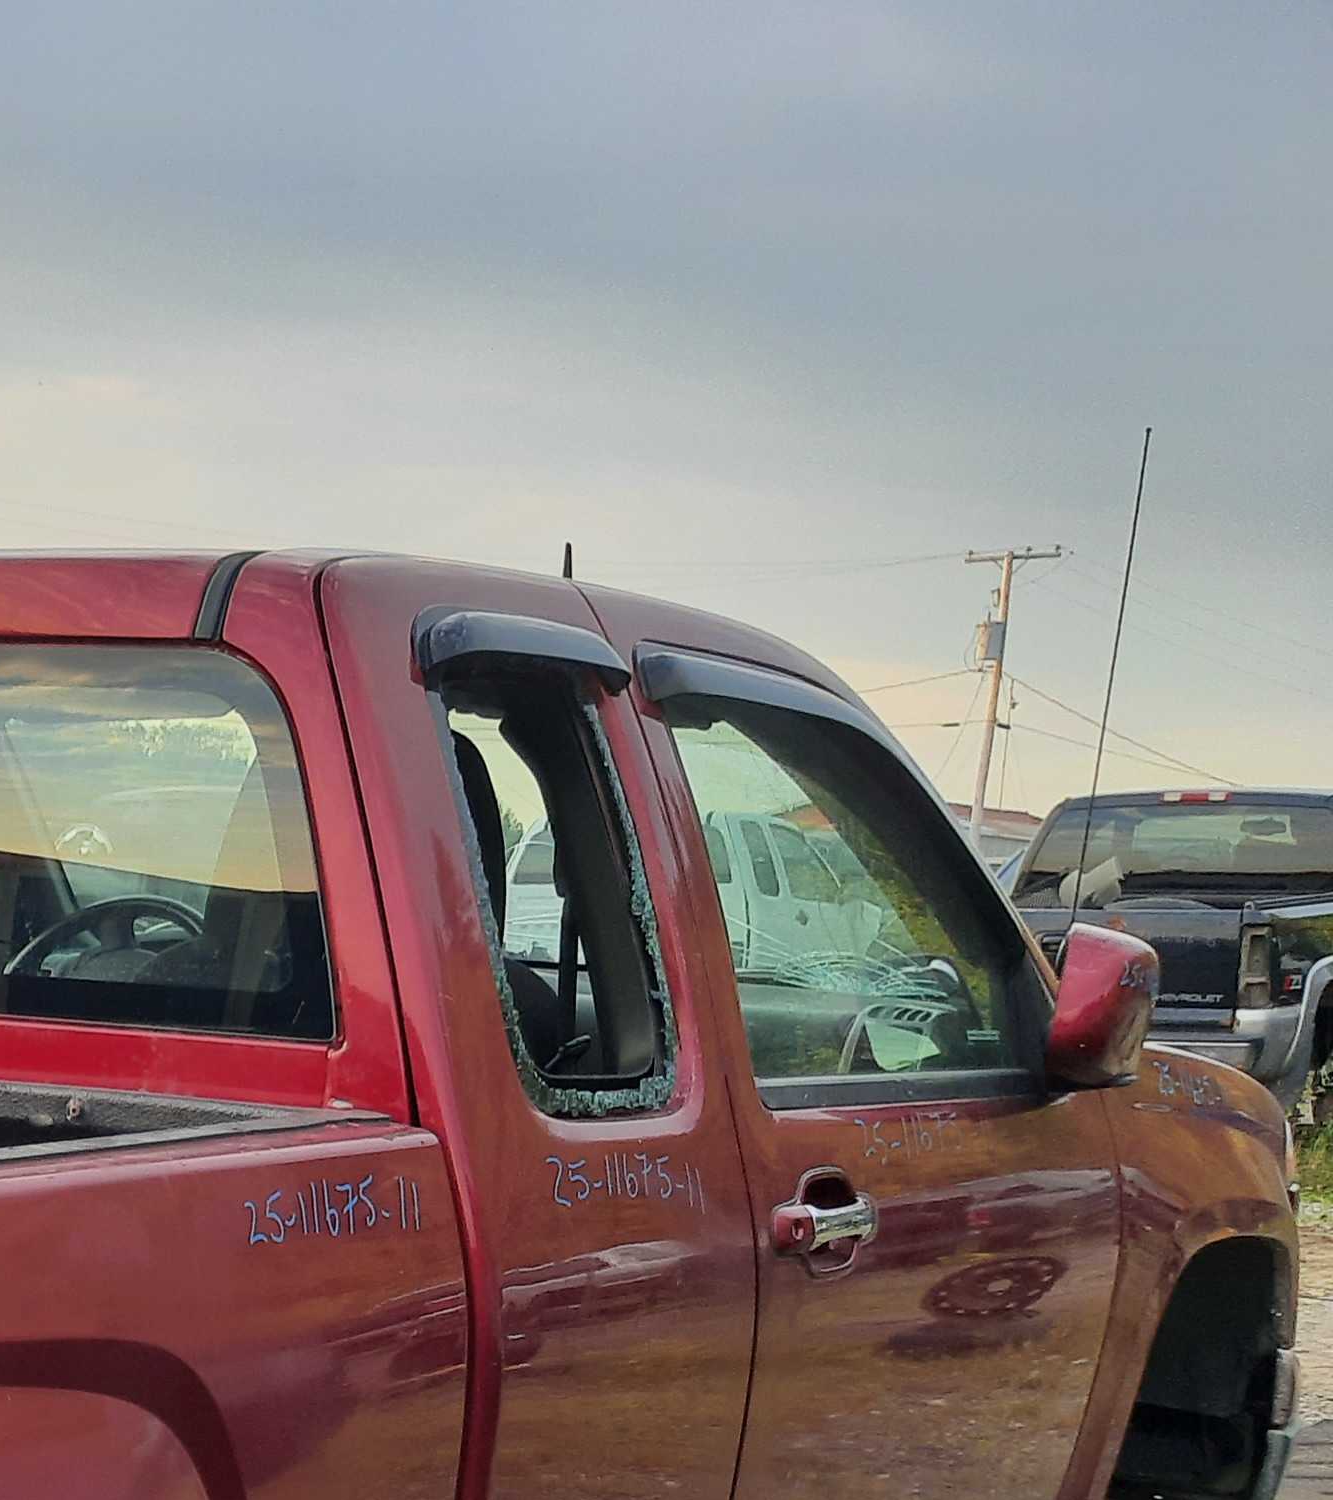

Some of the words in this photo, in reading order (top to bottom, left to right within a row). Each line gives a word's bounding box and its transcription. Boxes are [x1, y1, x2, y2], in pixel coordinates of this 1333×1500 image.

[1155, 992, 1225, 1004] HEVROLET
[244, 1173, 421, 1246] 25-11675-11
[545, 1151, 707, 1216] 25-11675-11
